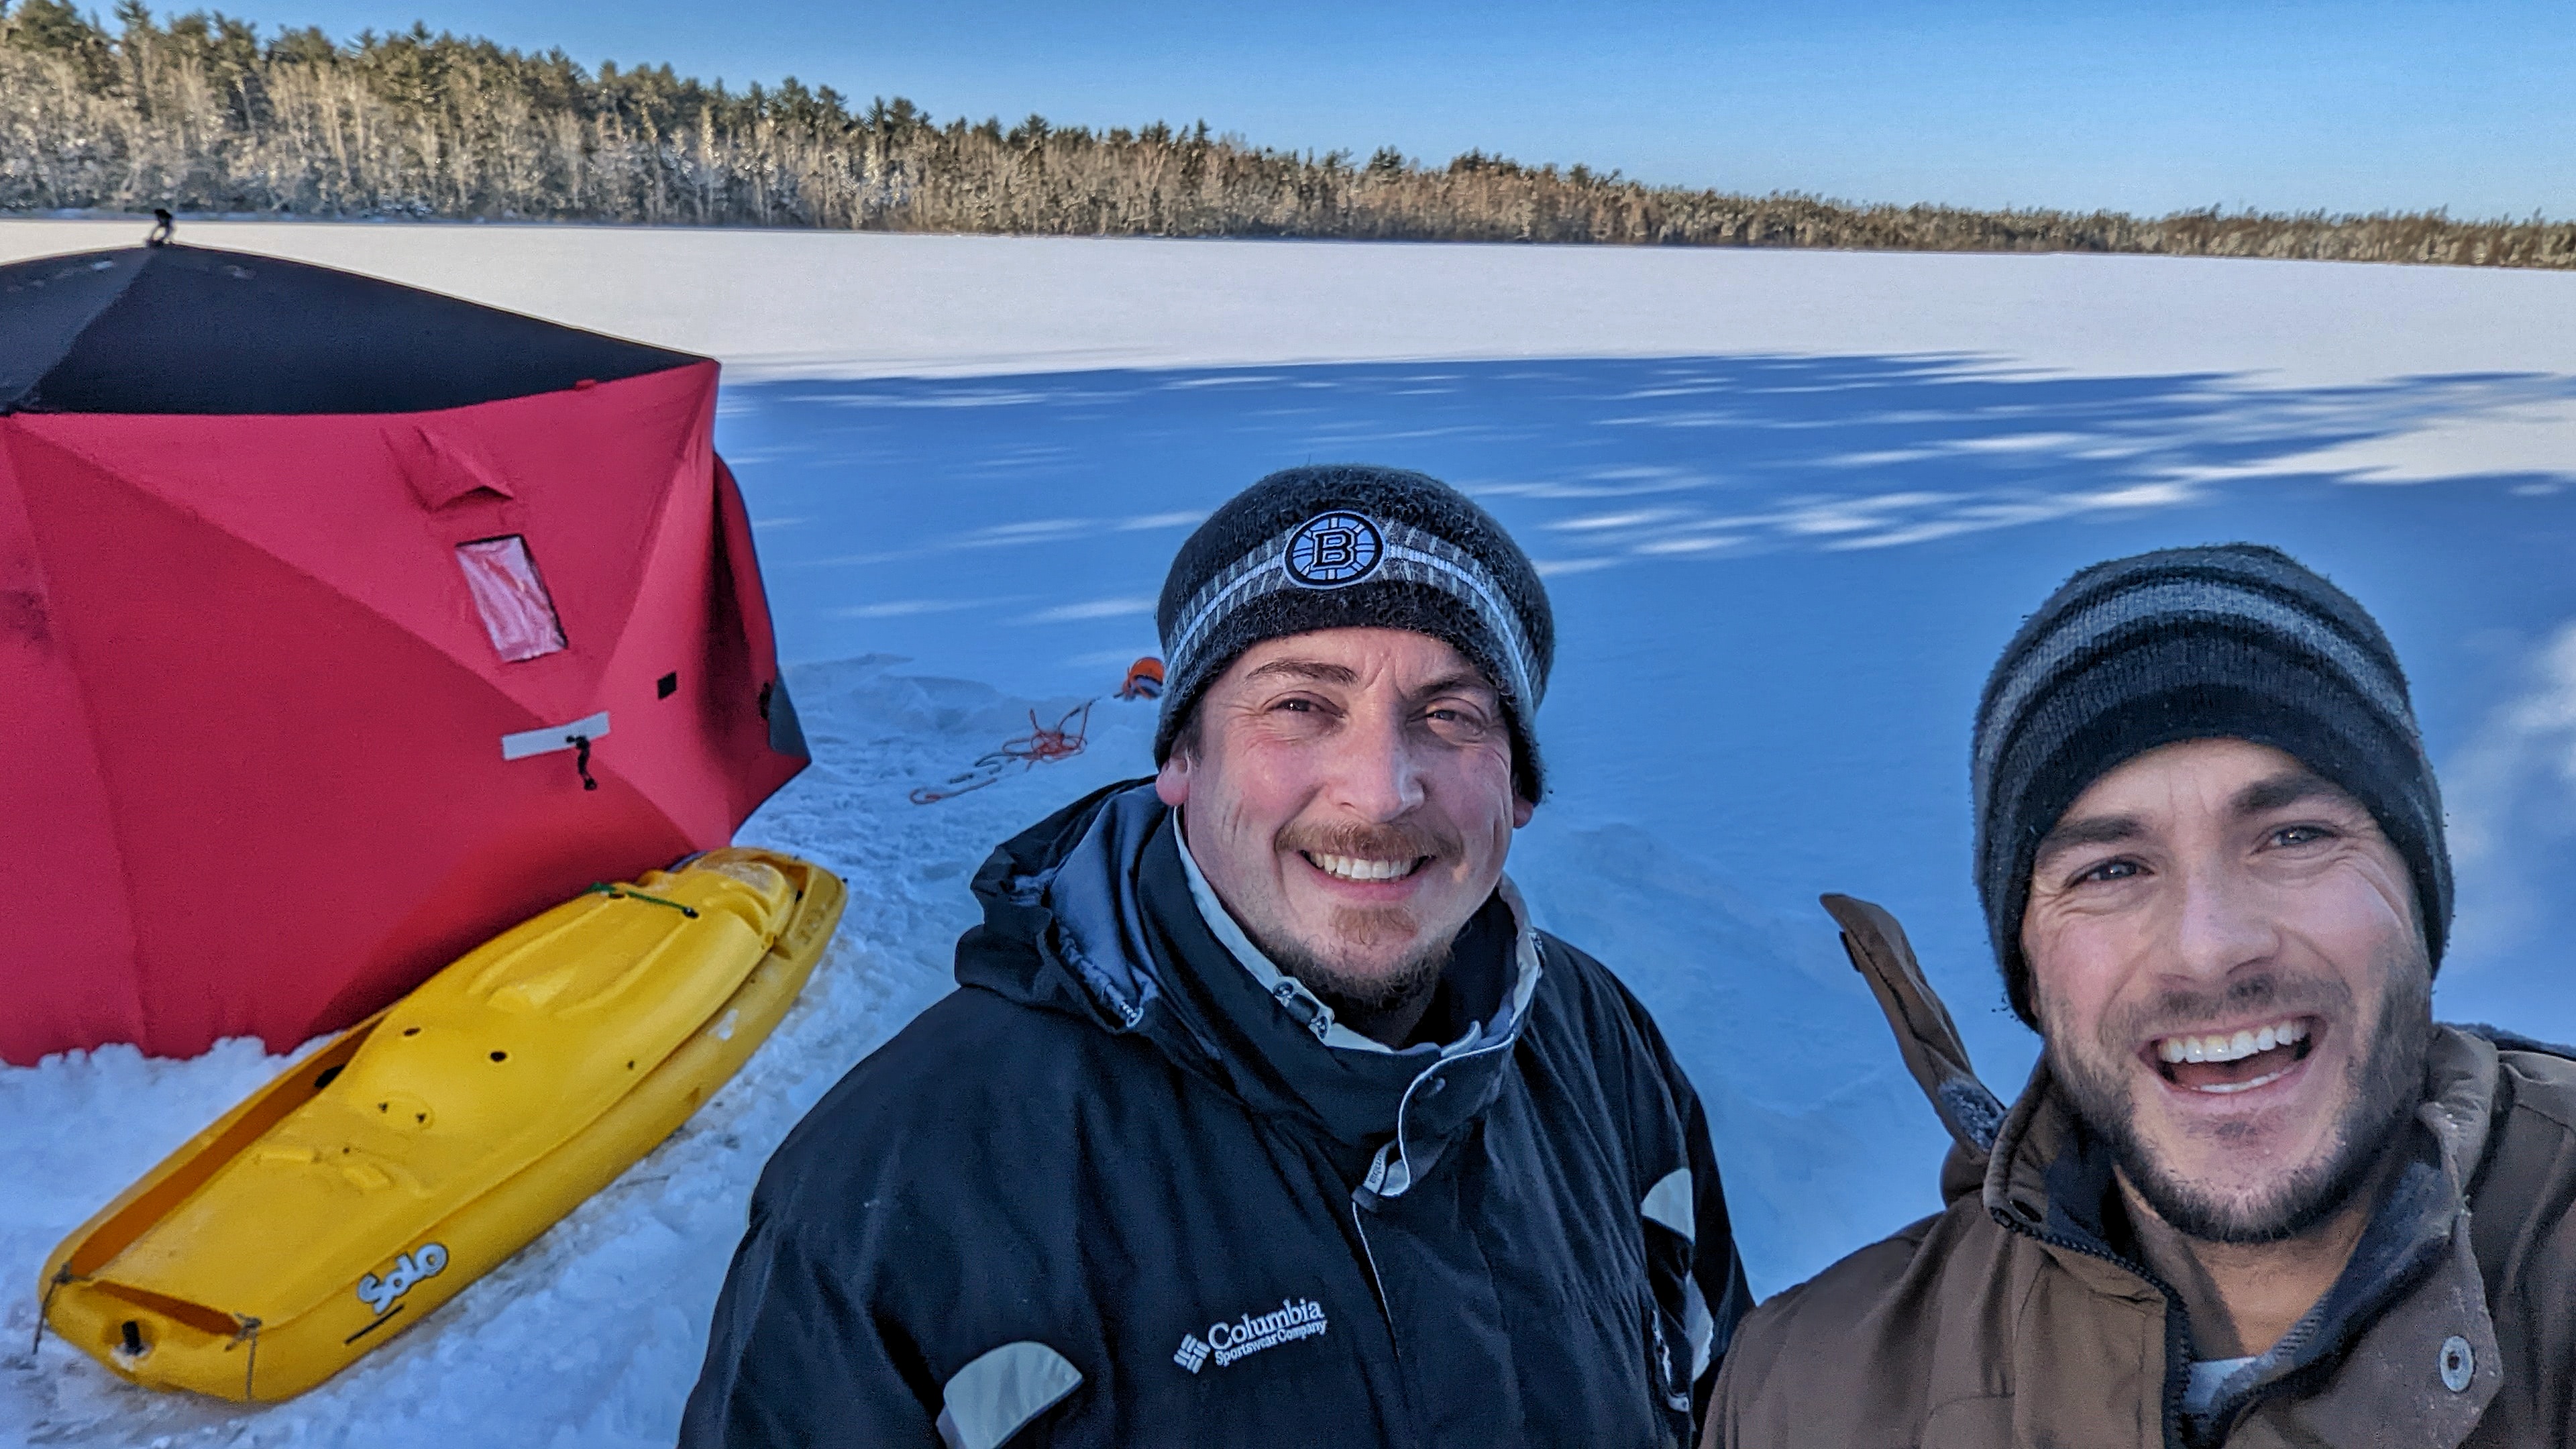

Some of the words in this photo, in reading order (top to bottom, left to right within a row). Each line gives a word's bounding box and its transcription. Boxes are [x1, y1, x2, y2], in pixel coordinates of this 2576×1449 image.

[1309, 528, 1354, 570] B
[1208, 1298, 1325, 1350] Columbia
[1215, 1334, 1278, 1366] Sportswear
[1277, 1320, 1328, 1342] Company
